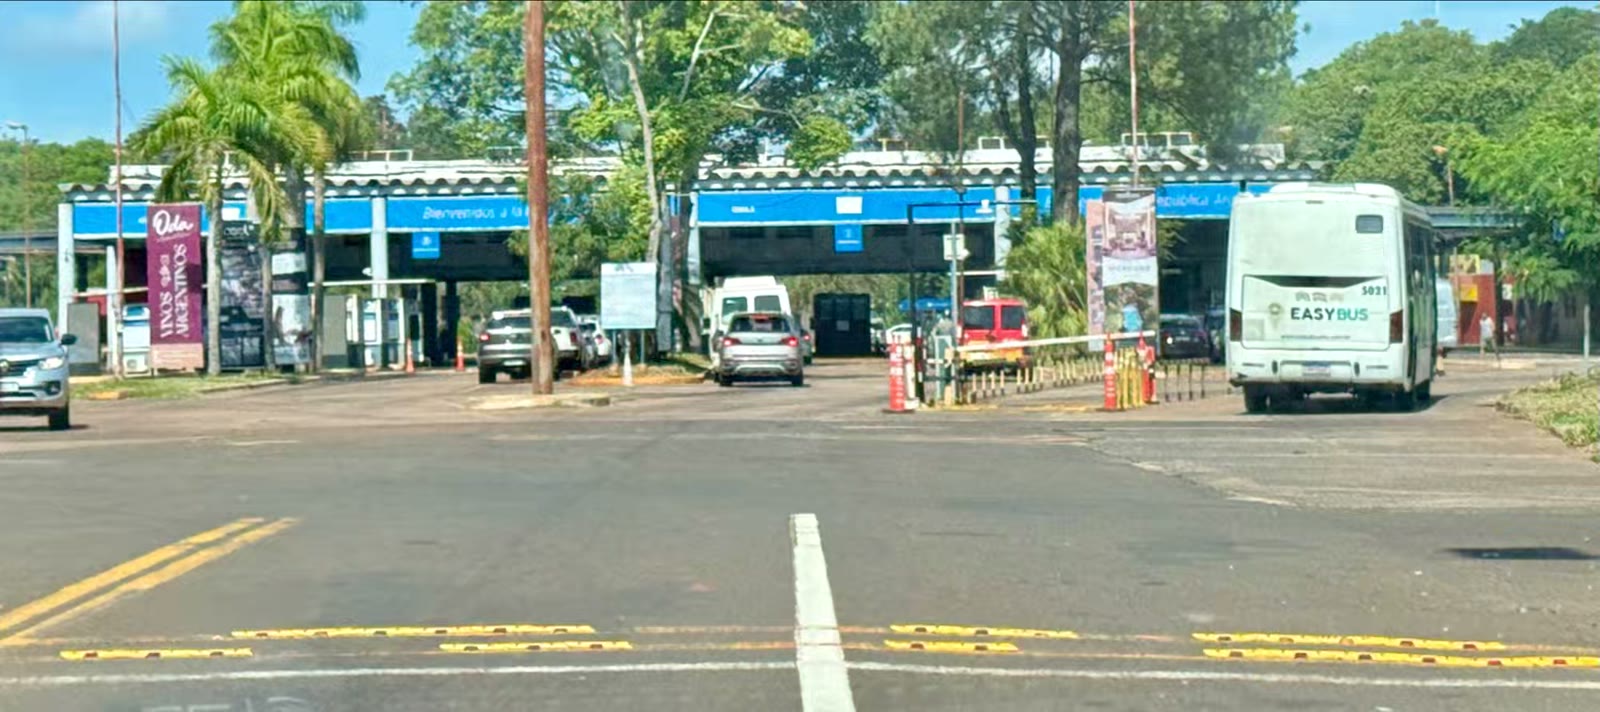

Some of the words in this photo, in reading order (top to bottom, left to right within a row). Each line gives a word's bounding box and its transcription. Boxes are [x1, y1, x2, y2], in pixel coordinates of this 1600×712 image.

[152, 210, 194, 236] Oda
[422, 206, 495, 219] Bienvenidos
[173, 243, 189, 338] ARGENTINOS
[1362, 286, 1387, 296] 5021
[159, 291, 173, 338] VINOS
